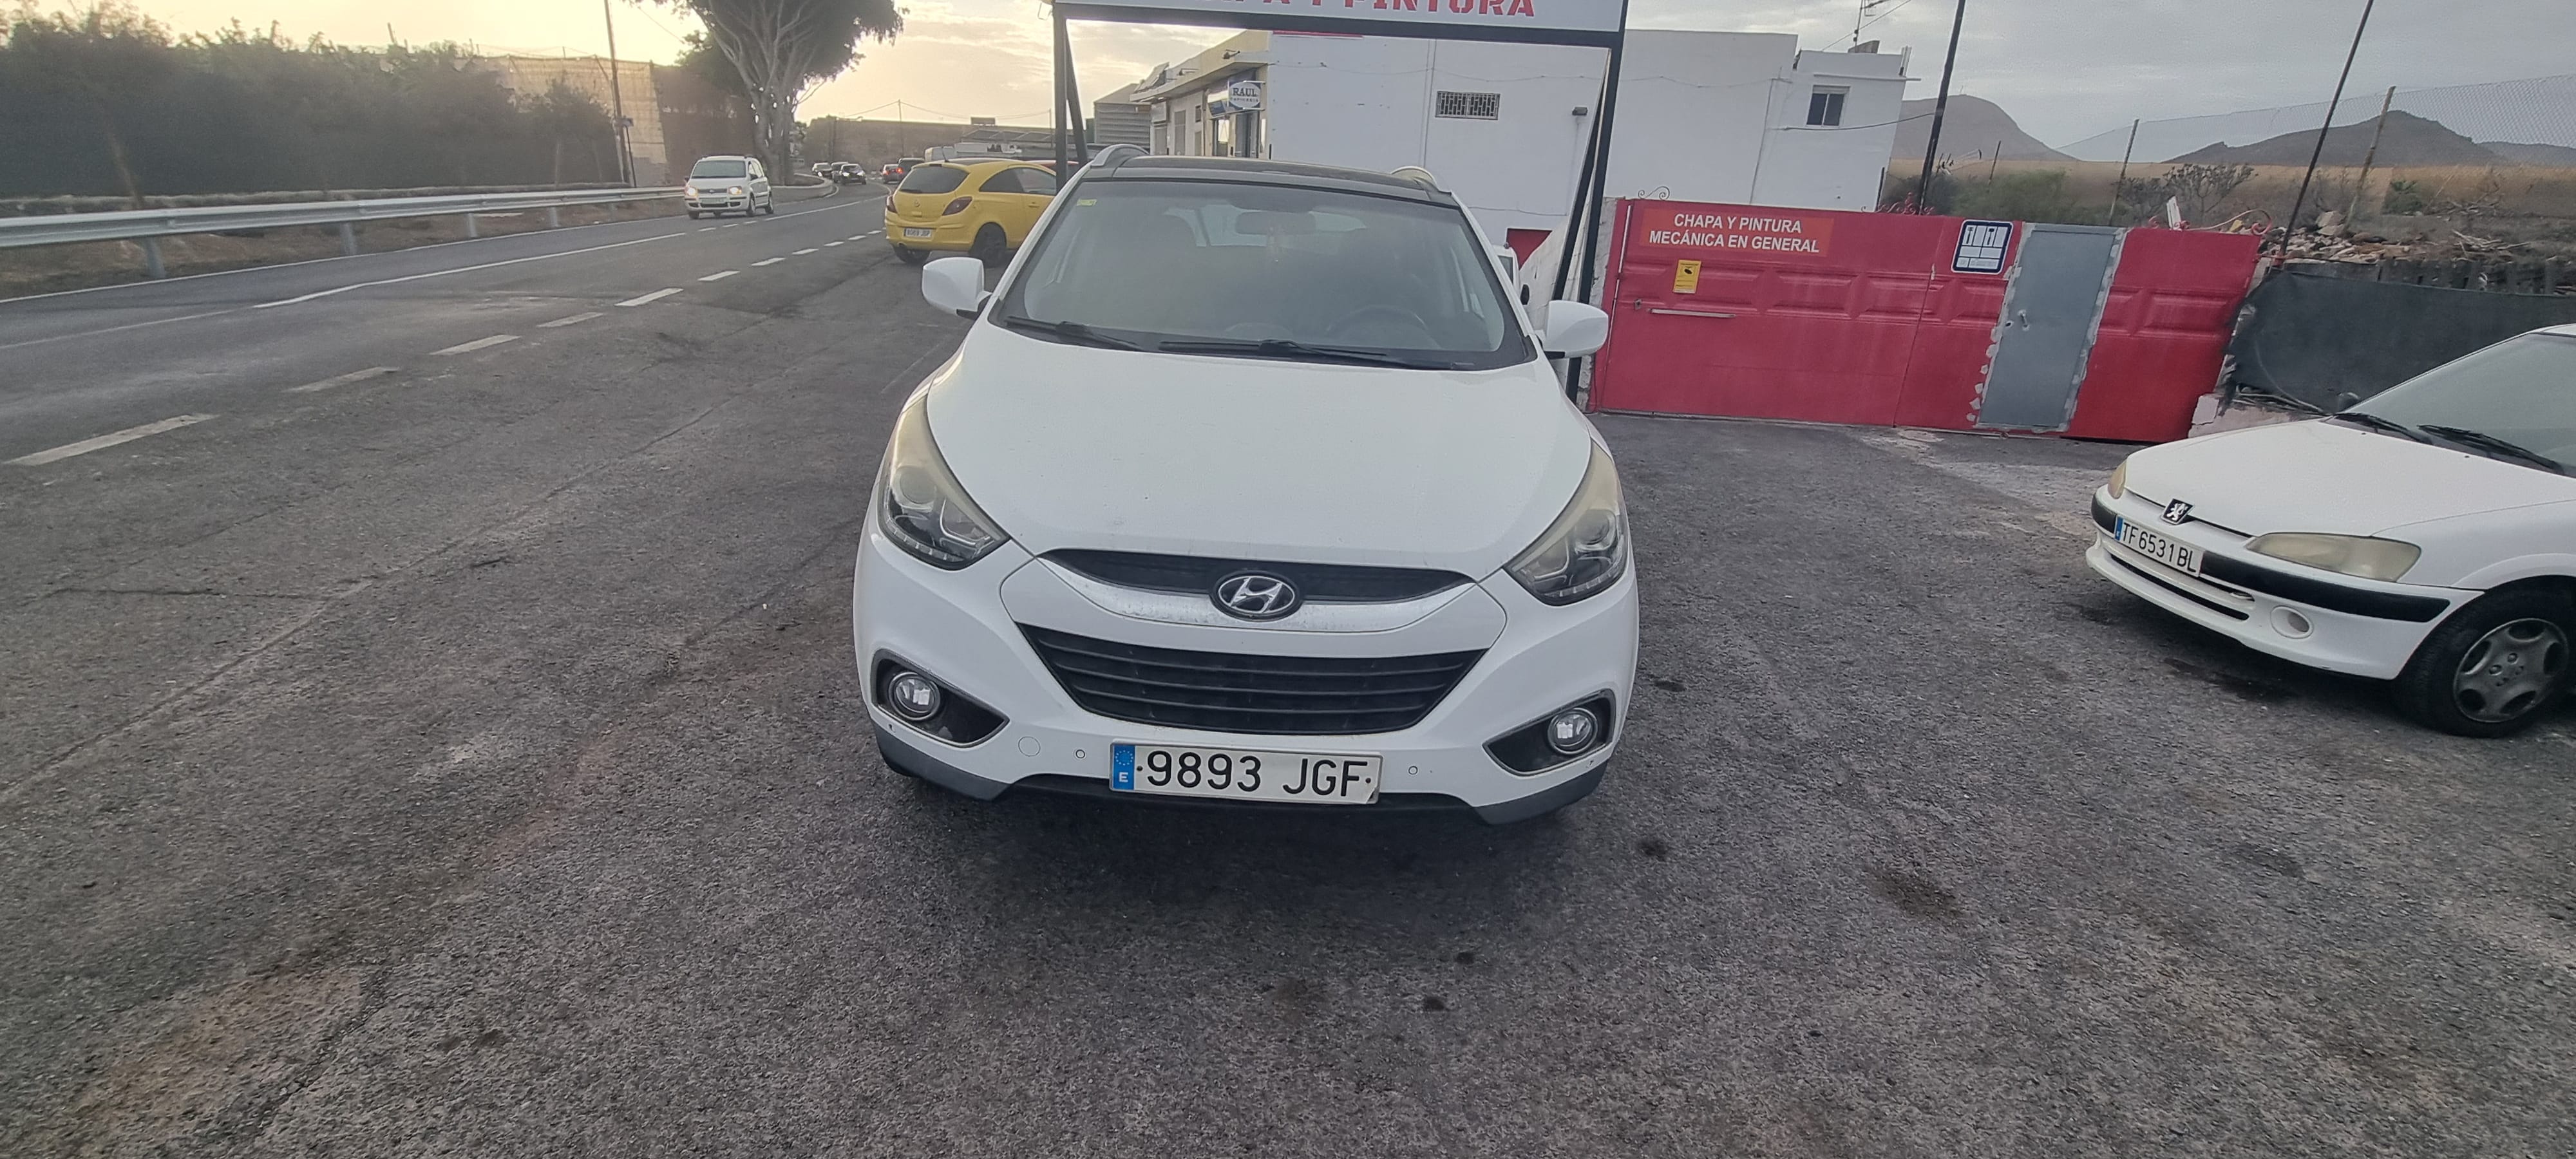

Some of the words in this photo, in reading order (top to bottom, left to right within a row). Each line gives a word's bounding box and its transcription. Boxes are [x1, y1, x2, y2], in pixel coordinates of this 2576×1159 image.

[1674, 213, 1723, 229] CHAPA
[1727, 216, 1737, 229] Y
[1739, 216, 1802, 234] PINTURA
[1649, 229, 1725, 248] MECÁNICA
[1728, 234, 1748, 249] EN
[1751, 236, 1820, 253] GENERAL
[1119, 771, 1129, 783] E
[1146, 749, 1262, 793] 9893
[1282, 758, 1368, 797] JGF
